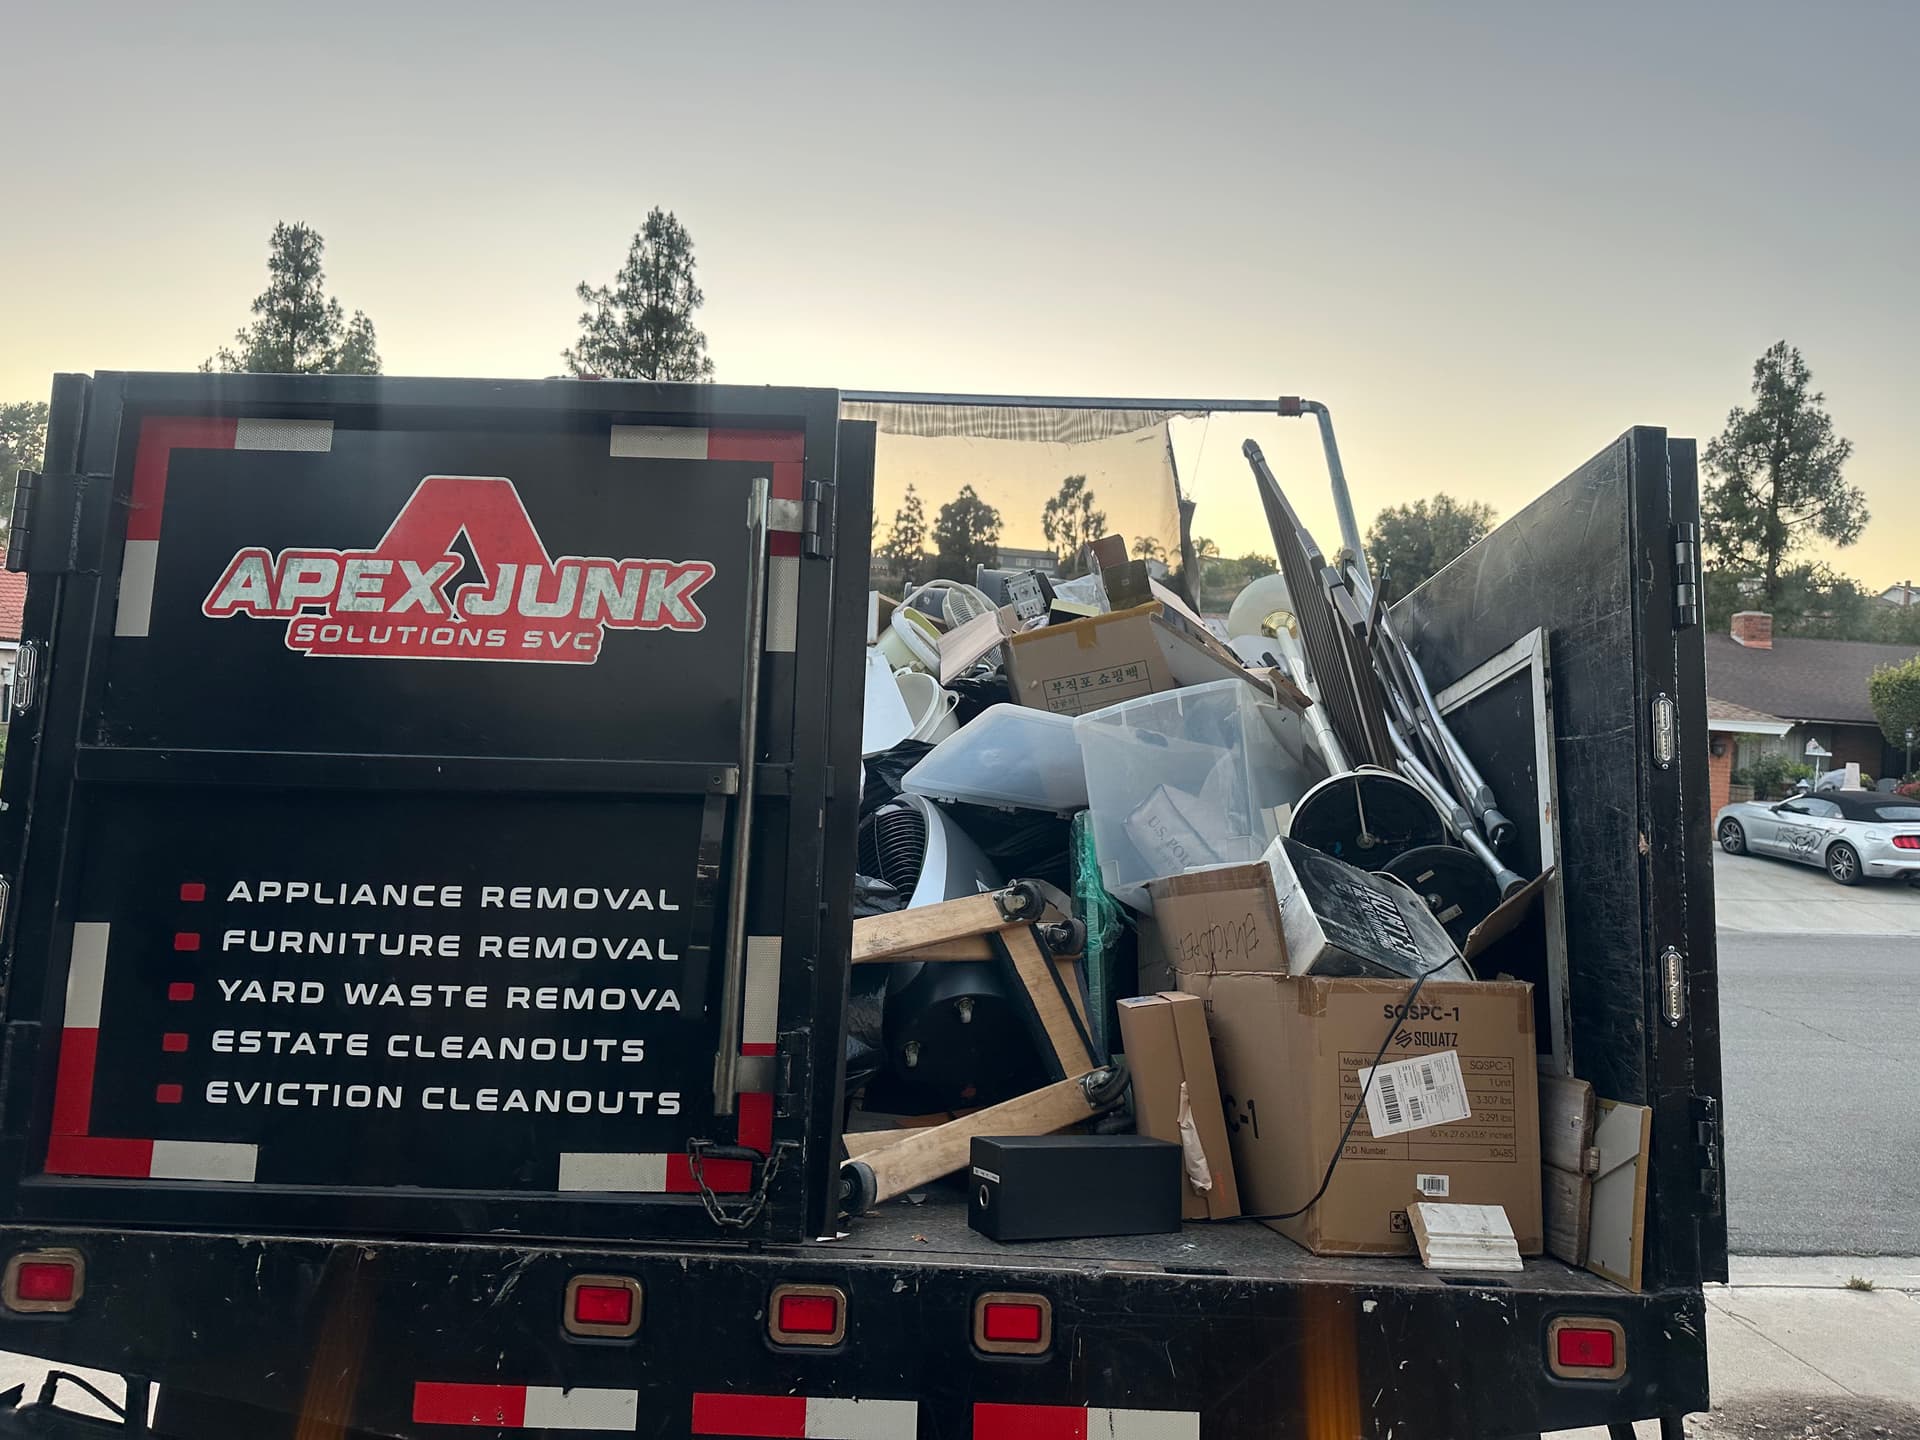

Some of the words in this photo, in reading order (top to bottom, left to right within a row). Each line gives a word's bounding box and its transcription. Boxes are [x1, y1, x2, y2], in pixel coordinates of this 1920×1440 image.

[211, 556, 455, 614] APEX
[463, 561, 706, 624] JUNK
[294, 623, 506, 648] SOLUTIONS
[520, 630, 595, 651] SVC
[1166, 837, 1195, 868] POL
[227, 880, 462, 907] APPLIANCE
[480, 887, 680, 911] REMOVAL
[222, 929, 461, 957] FURNITURE
[479, 935, 679, 961] REMOVAL
[217, 979, 325, 1004] YARD
[344, 982, 488, 1008] WASTE
[506, 986, 681, 1011] REMOVA
[212, 1029, 369, 1057] ESTATE
[387, 1035, 644, 1062] CLEANOUTS
[1414, 1031, 1458, 1048] SQUATZ
[1343, 1057, 1363, 1066] Model
[206, 1081, 403, 1109] EVICTION
[422, 1087, 681, 1115] CLEANOUTS
